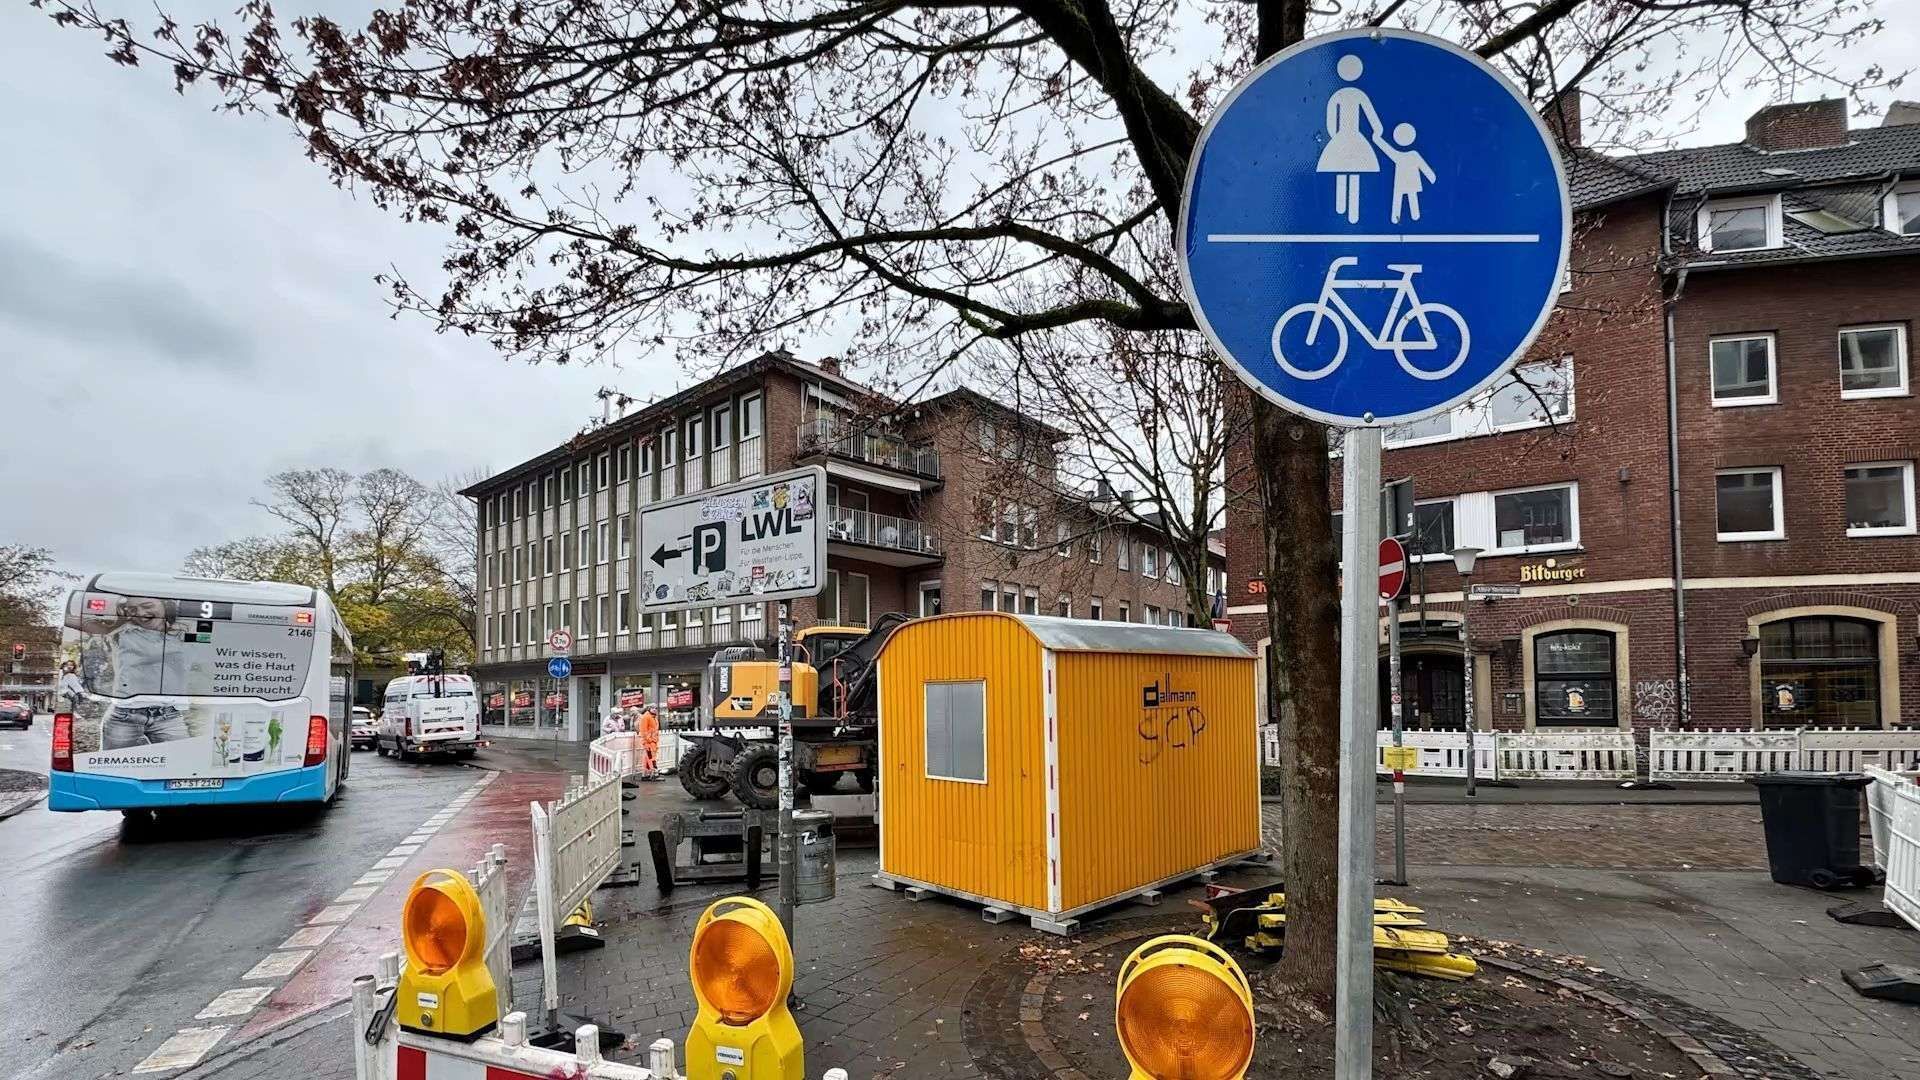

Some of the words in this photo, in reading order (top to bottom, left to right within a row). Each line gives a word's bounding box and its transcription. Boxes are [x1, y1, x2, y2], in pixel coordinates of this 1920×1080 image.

[741, 508, 802, 542] LWL
[701, 528, 721, 567] P
[1520, 564, 1585, 582] Bitburger
[200, 601, 213, 619] 9
[288, 628, 313, 638] 2146
[216, 647, 239, 657] Wir
[214, 661, 239, 669] was
[242, 660, 262, 670] die
[266, 661, 295, 672] Haut
[214, 673, 241, 681] zum
[245, 672, 296, 683] Gesund-
[213, 684, 239, 693] sein
[243, 683, 294, 695] braucht.
[1143, 672, 1196, 708] dallmann
[769, 693, 777, 703] 20
[88, 756, 167, 765] DERMASENCE
